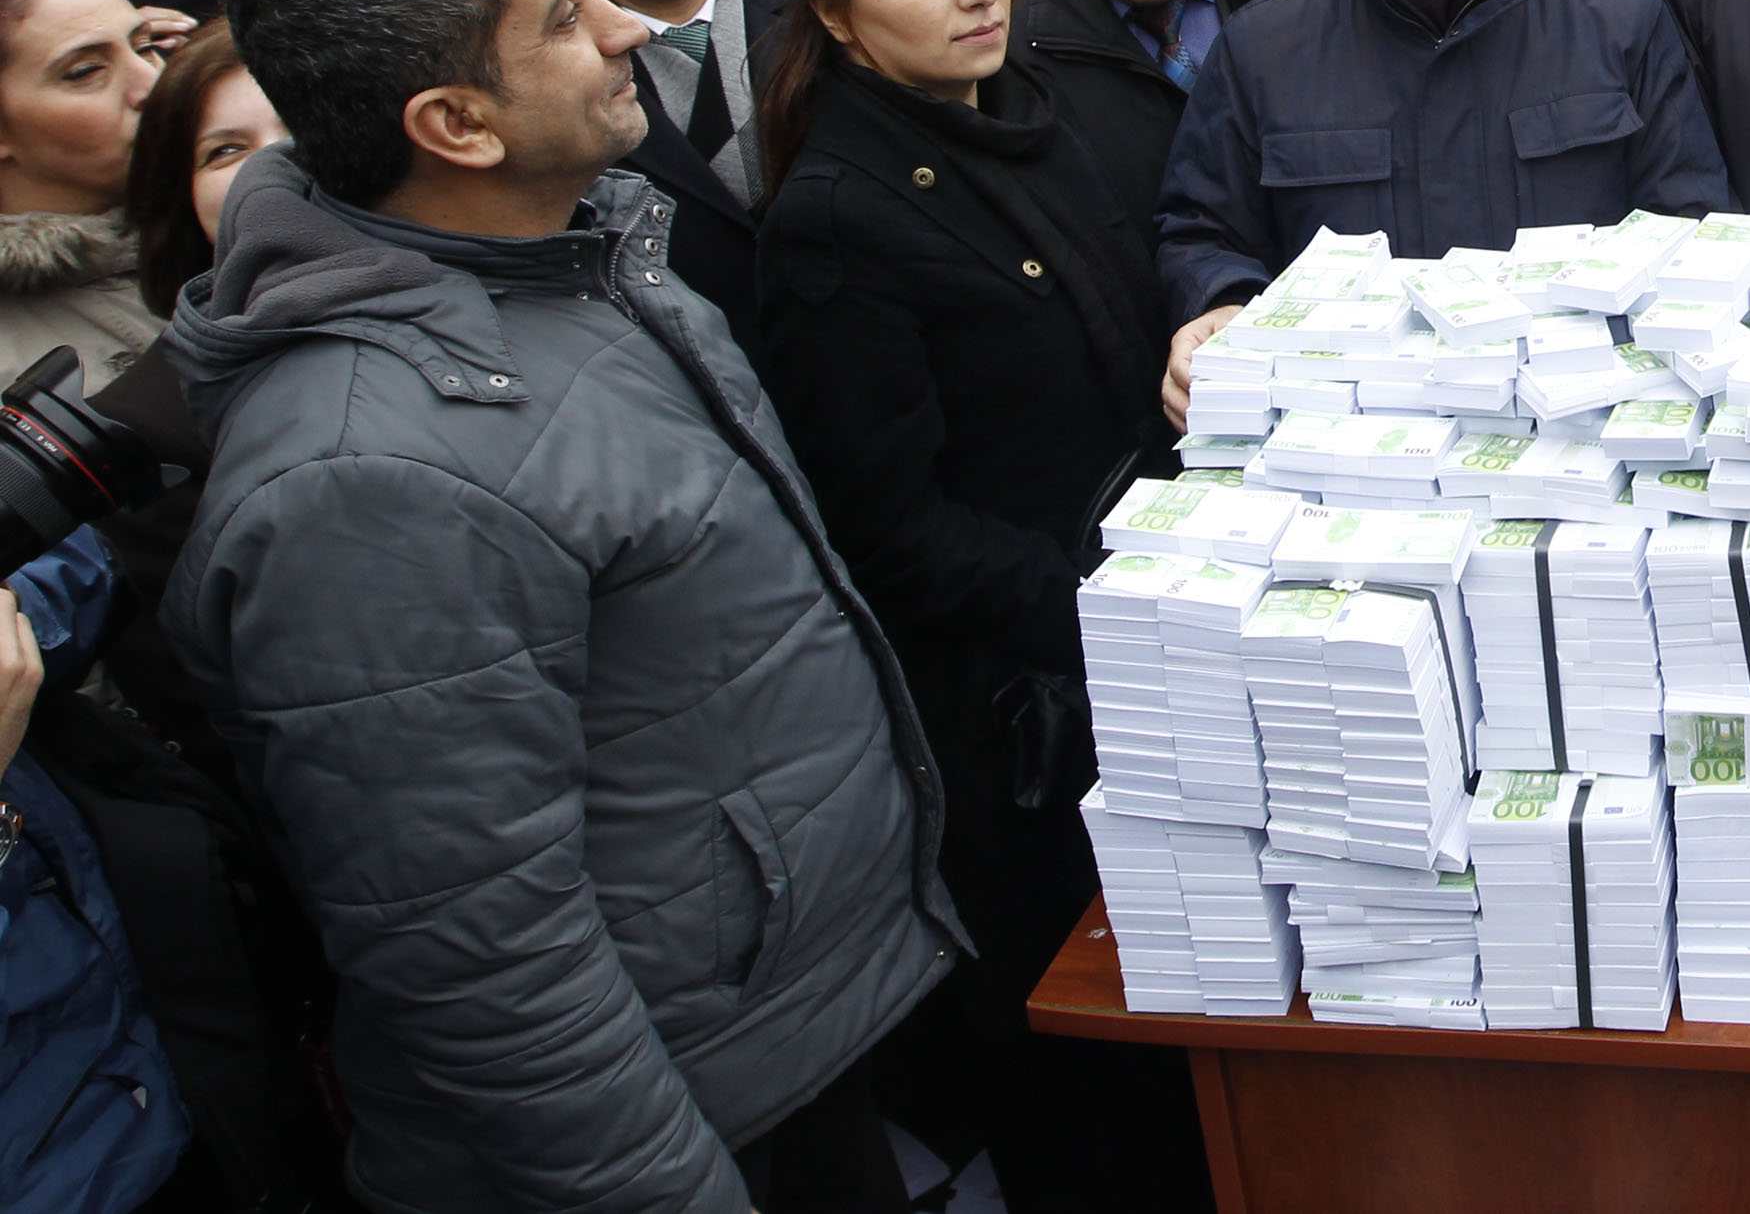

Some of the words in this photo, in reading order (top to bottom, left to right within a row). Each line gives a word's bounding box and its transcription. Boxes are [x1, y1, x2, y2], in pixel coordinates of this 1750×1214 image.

[1403, 446, 1432, 457] 100
[1690, 759, 1746, 782] 100
[1492, 800, 1547, 820] 100
